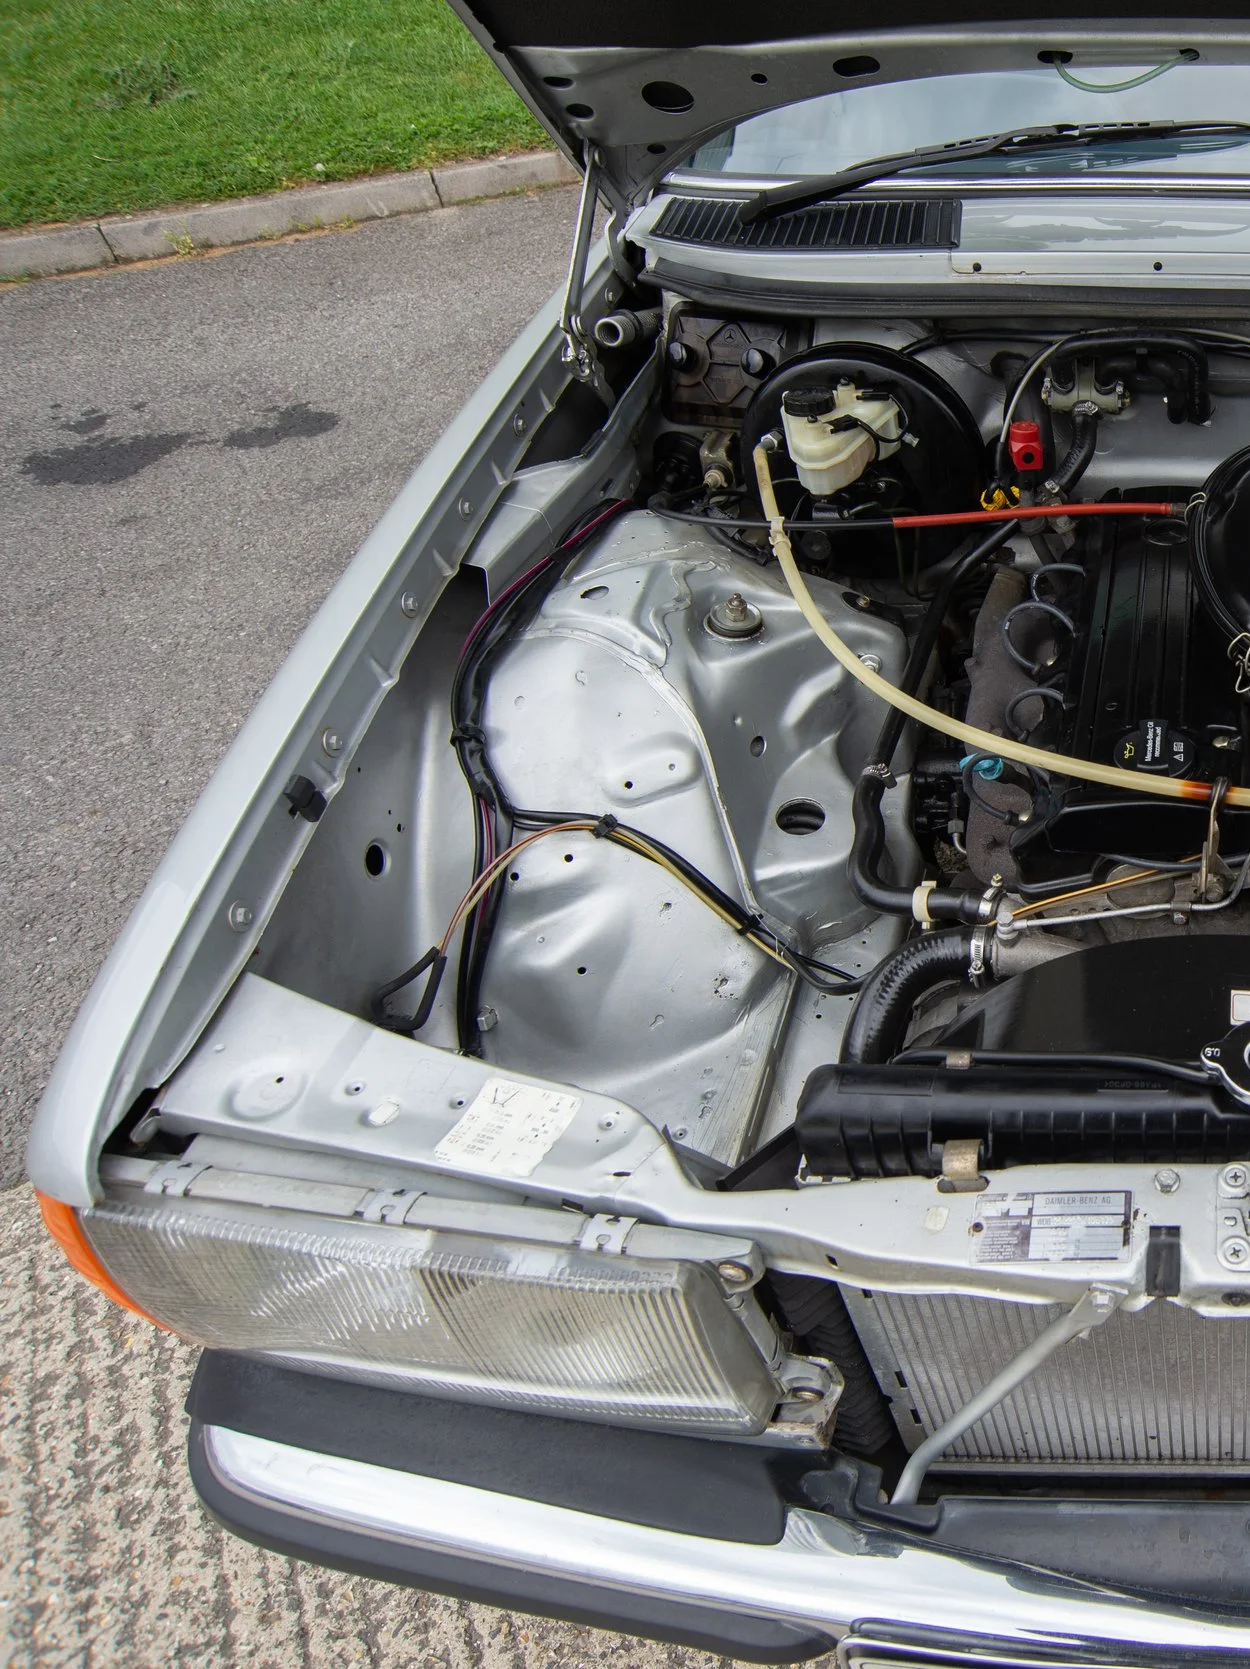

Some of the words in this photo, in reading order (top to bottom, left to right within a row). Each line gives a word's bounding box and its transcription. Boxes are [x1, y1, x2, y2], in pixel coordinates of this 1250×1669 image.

[1145, 727, 1154, 762] Mercedes-Benz
[1045, 1196, 1098, 1205] DAIMLER-BENZ
[1101, 1196, 1111, 1204] AG
